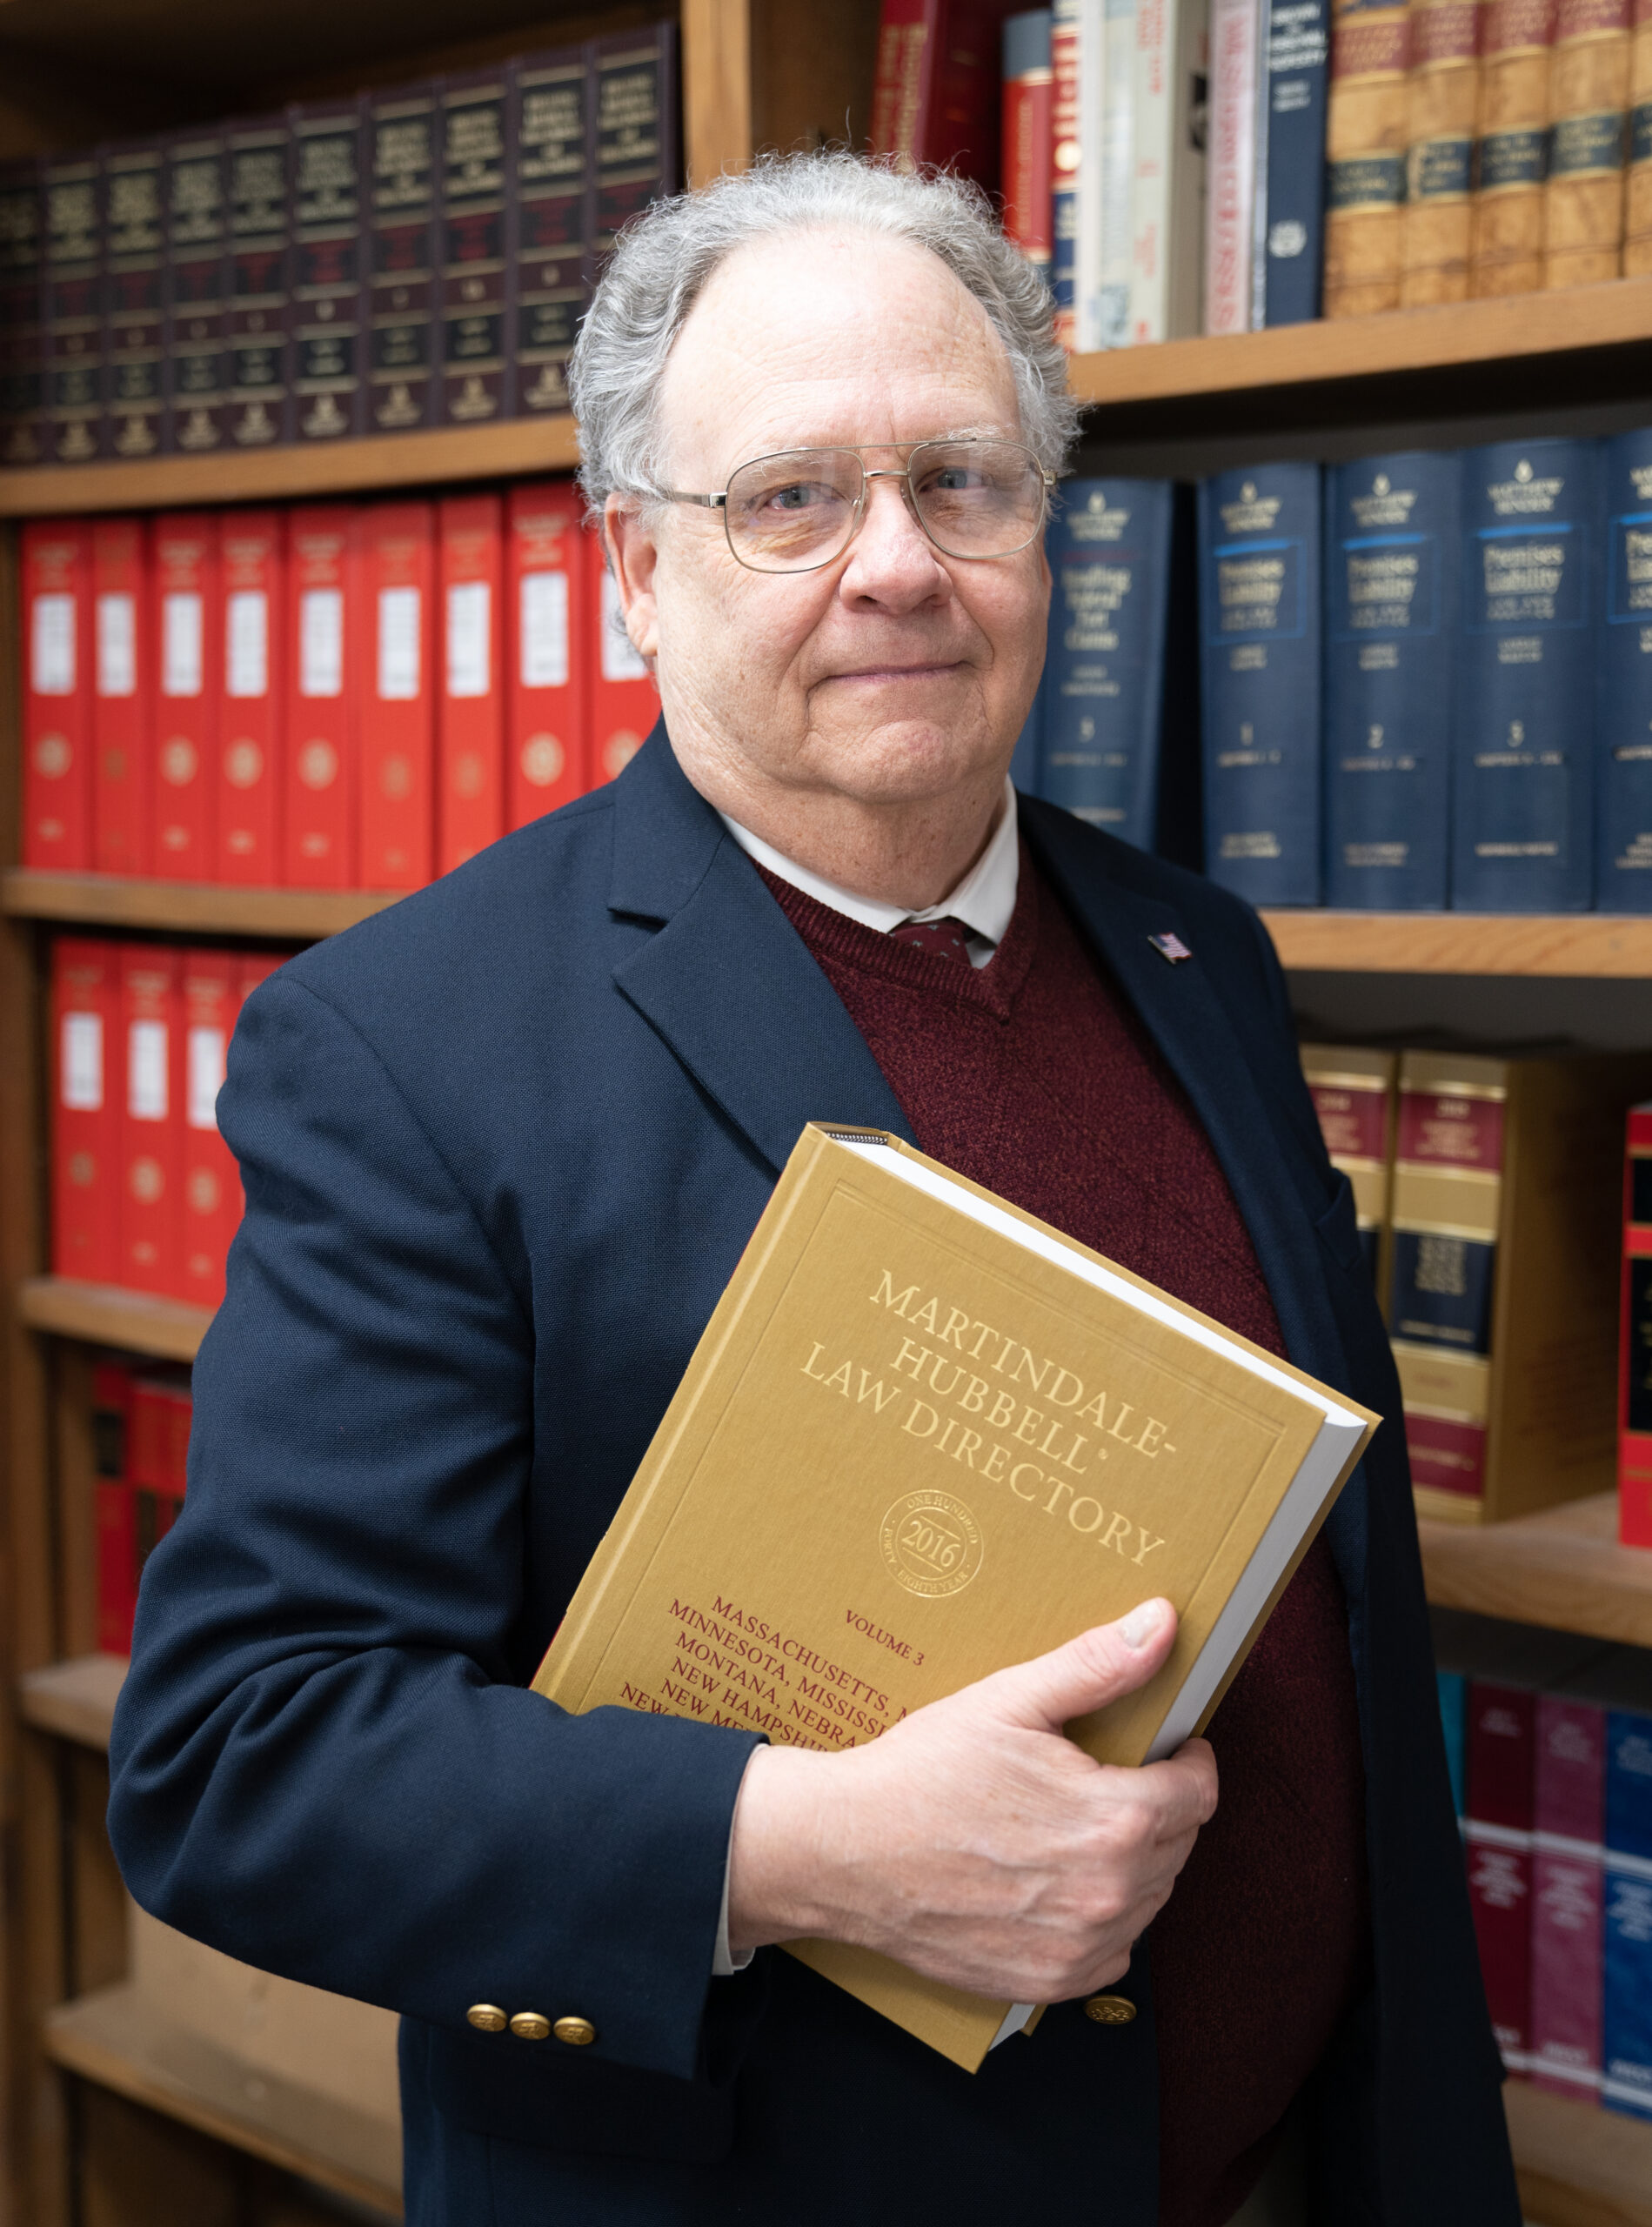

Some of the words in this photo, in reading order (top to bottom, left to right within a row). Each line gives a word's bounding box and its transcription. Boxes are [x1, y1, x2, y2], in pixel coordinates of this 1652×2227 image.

[870, 1267, 1177, 1459] MARTINDALE-
[799, 1341, 902, 1414] LAW
[900, 1398, 1166, 1567] DIRECTORY
[906, 1495, 933, 1509] ONE
[901, 1520, 961, 1568] 2016
[711, 1595, 889, 1718] MASSACHUSETTS,
[846, 1608, 913, 1660] VOLUME
[913, 1652, 925, 1667] 3
[660, 1677, 711, 1716] NEW
[668, 1598, 791, 1687] MINNESOTA,
[797, 1675, 889, 1739] MISSISSI
[671, 1655, 721, 1695] NEW
[675, 1630, 780, 1710] MONTANA,
[787, 1698, 859, 1749] NEBRA
[619, 1681, 670, 1716] NEW
